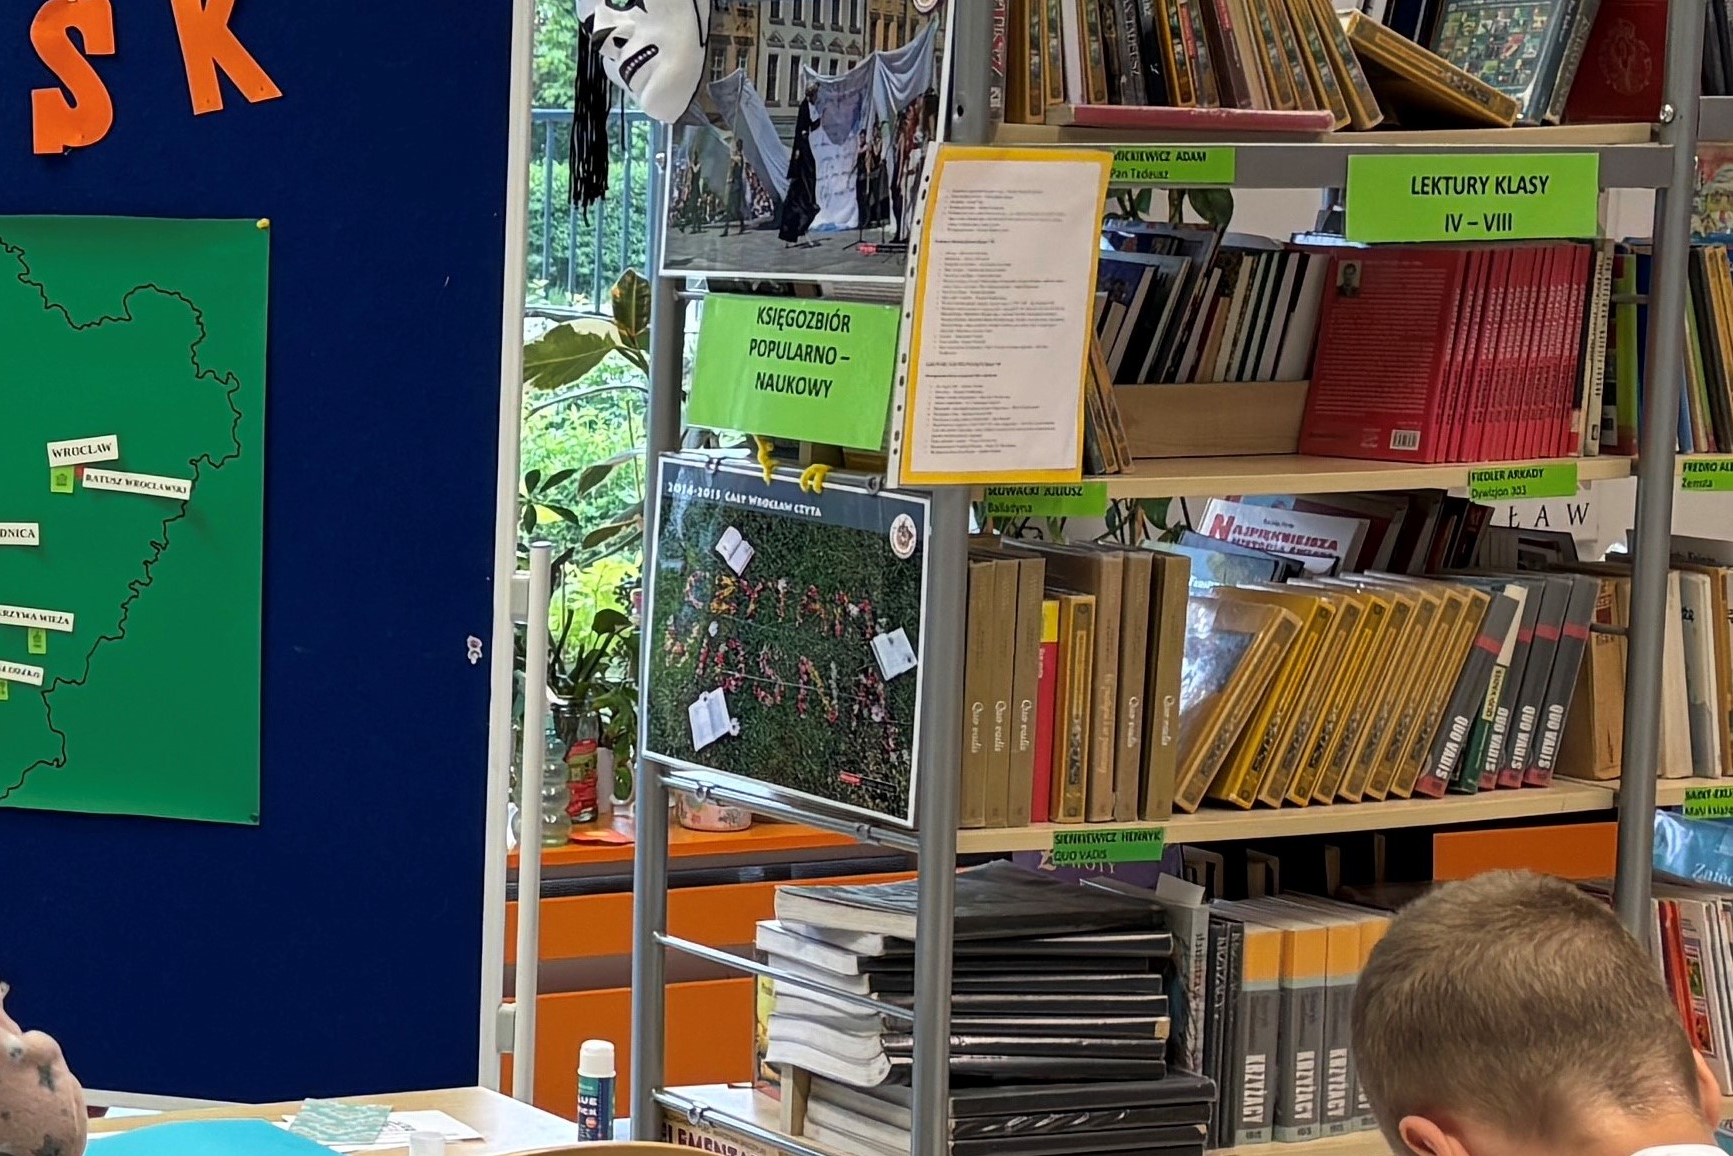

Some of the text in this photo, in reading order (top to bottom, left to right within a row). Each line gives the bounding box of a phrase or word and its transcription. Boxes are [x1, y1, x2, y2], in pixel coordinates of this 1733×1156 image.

[1176, 151, 1207, 162] ADAM
[1411, 175, 1549, 195] LEKTURY KLASY
[1444, 213, 1463, 232] IV
[1483, 212, 1513, 232] VIII
[756, 306, 851, 333] KSIĘGOZBIÓR
[749, 338, 837, 365] POPULARNO
[755, 371, 833, 399] NAUKOWY
[1471, 468, 1545, 482] FIEDLER ARKADY
[1435, 715, 1469, 780] QUO VADIS
[1485, 706, 1510, 772] QUO VADIS
[1511, 705, 1536, 770] QUO VADIS
[1538, 704, 1564, 769] QUO VADIS
[1054, 851, 1077, 861] QUO
